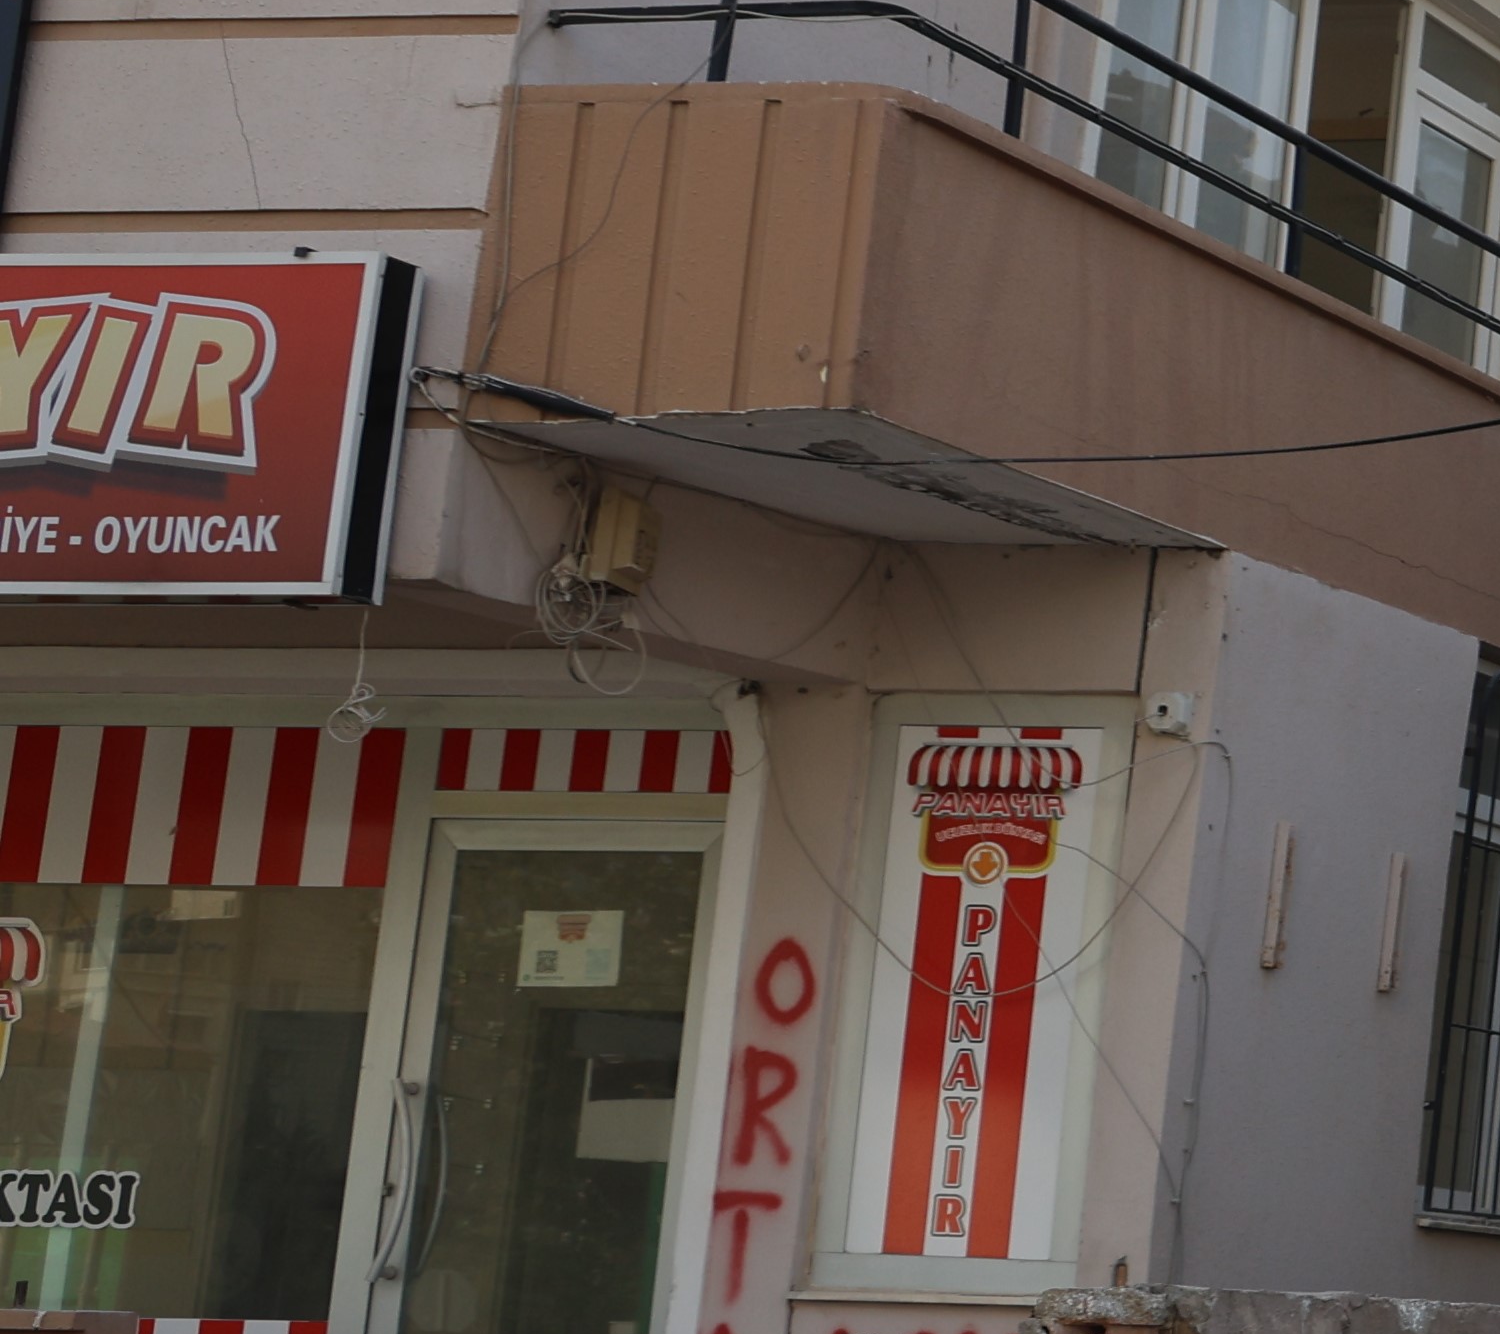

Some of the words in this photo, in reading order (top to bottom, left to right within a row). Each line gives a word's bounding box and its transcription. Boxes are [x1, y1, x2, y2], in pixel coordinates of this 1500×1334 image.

[94, 514, 280, 554] OYUNCAK
[911, 792, 1067, 819] PANAYIR
[929, 903, 997, 1238] PANAYIR
